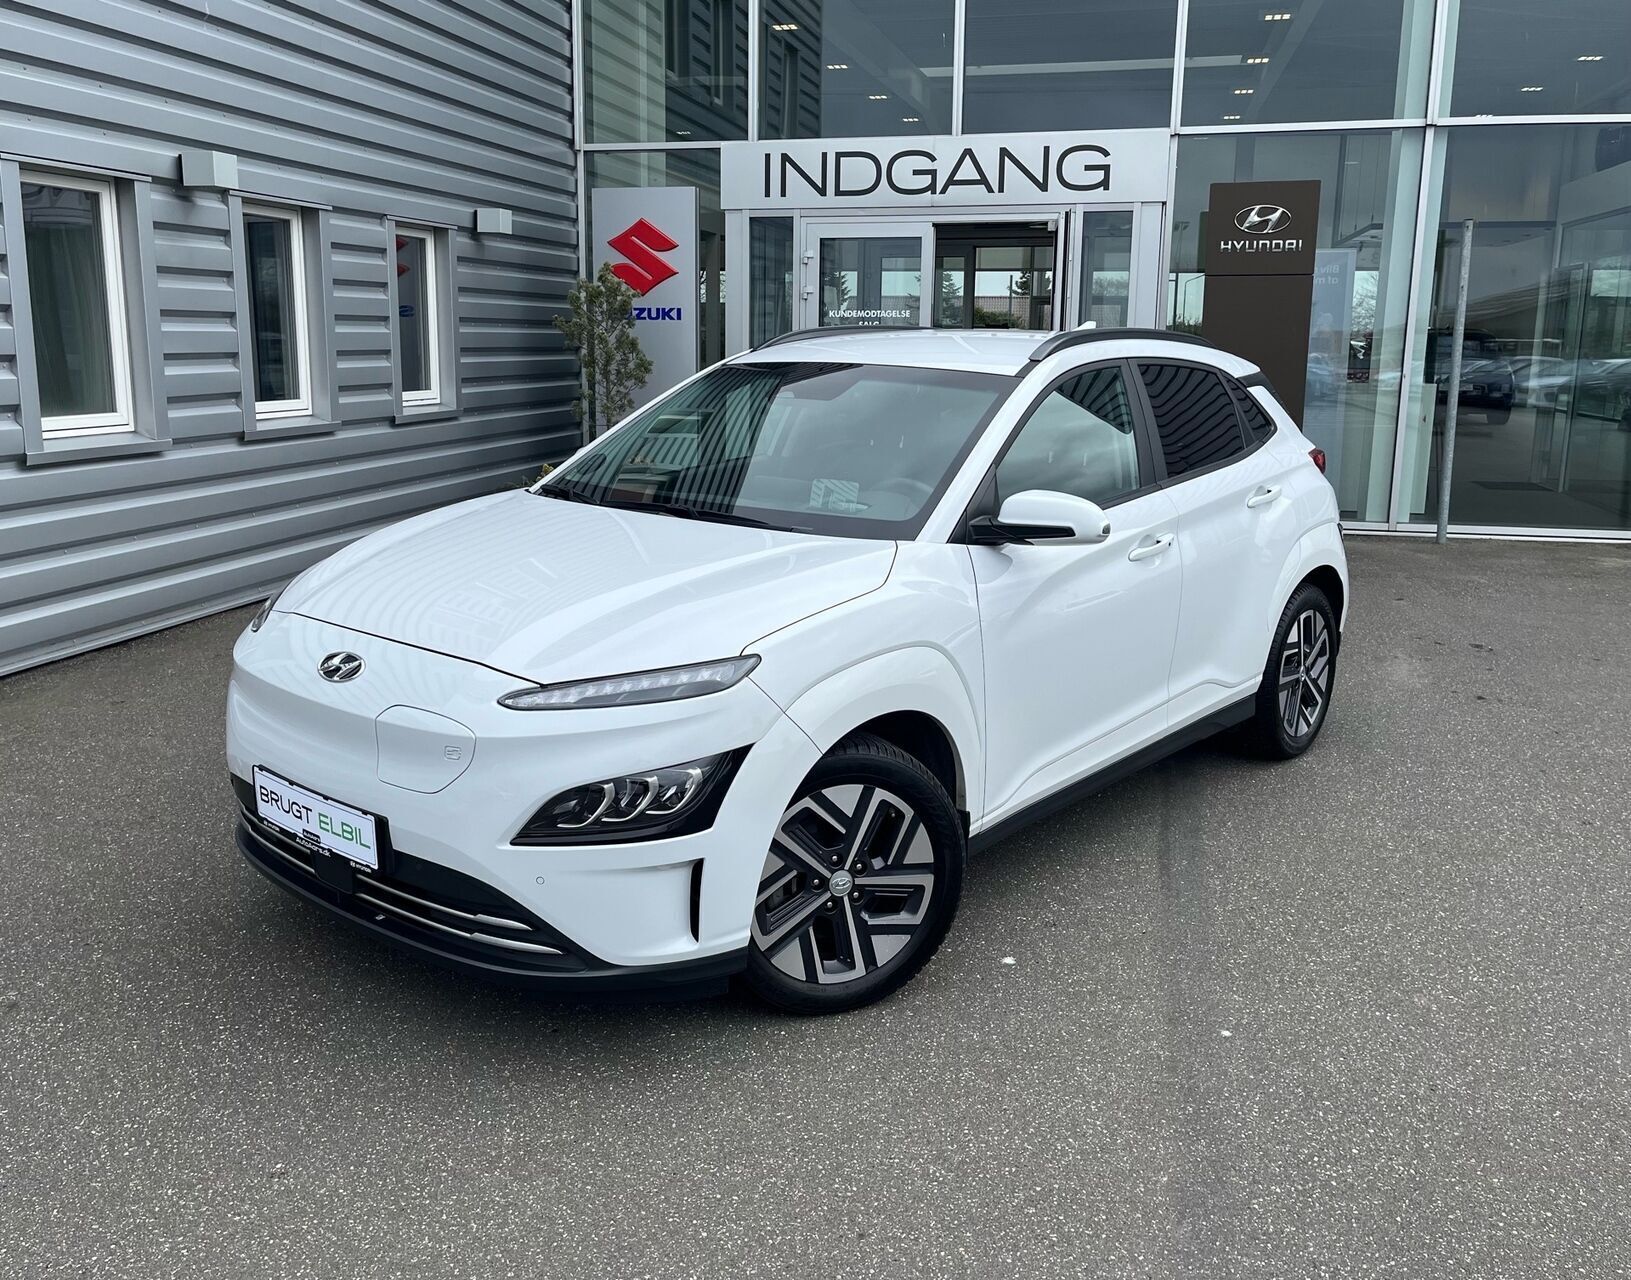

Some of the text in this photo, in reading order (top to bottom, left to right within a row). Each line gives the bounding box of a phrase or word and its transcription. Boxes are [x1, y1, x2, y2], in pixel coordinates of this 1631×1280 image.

[764, 144, 1111, 198] INDGANG
[1220, 239, 1303, 252] HYUNDAI
[627, 307, 682, 320] ZUKI
[828, 309, 911, 318] KUNDEMODTAGELSE
[259, 785, 313, 824] BRUGT
[318, 812, 371, 850] ELBIL
